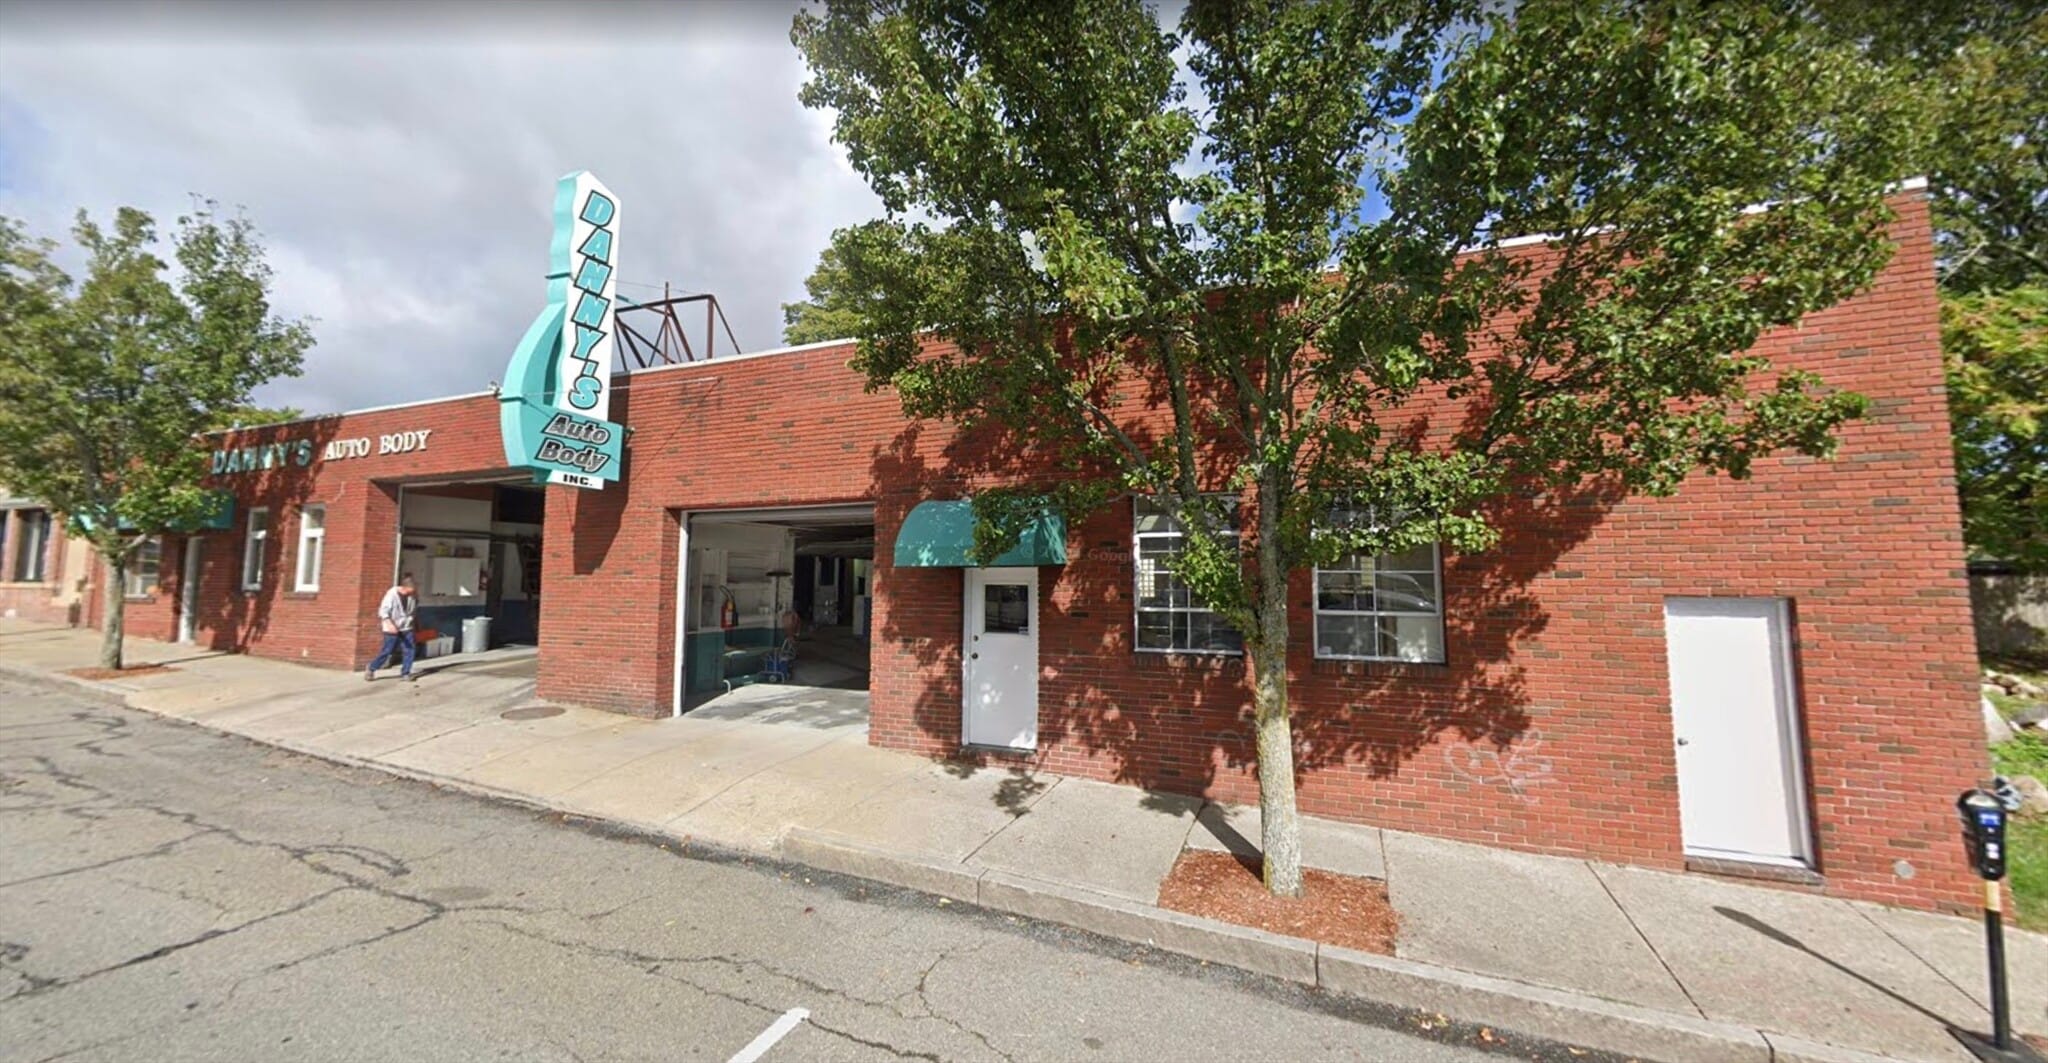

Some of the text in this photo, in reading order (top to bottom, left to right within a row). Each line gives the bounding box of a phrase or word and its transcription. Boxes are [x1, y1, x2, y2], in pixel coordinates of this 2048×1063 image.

[568, 189, 615, 410] DANNY'S
[541, 412, 611, 445] Auto
[211, 429, 432, 475] DANNY'S AUTO BODY
[534, 437, 611, 473] Body
[563, 474, 593, 487] INC.
